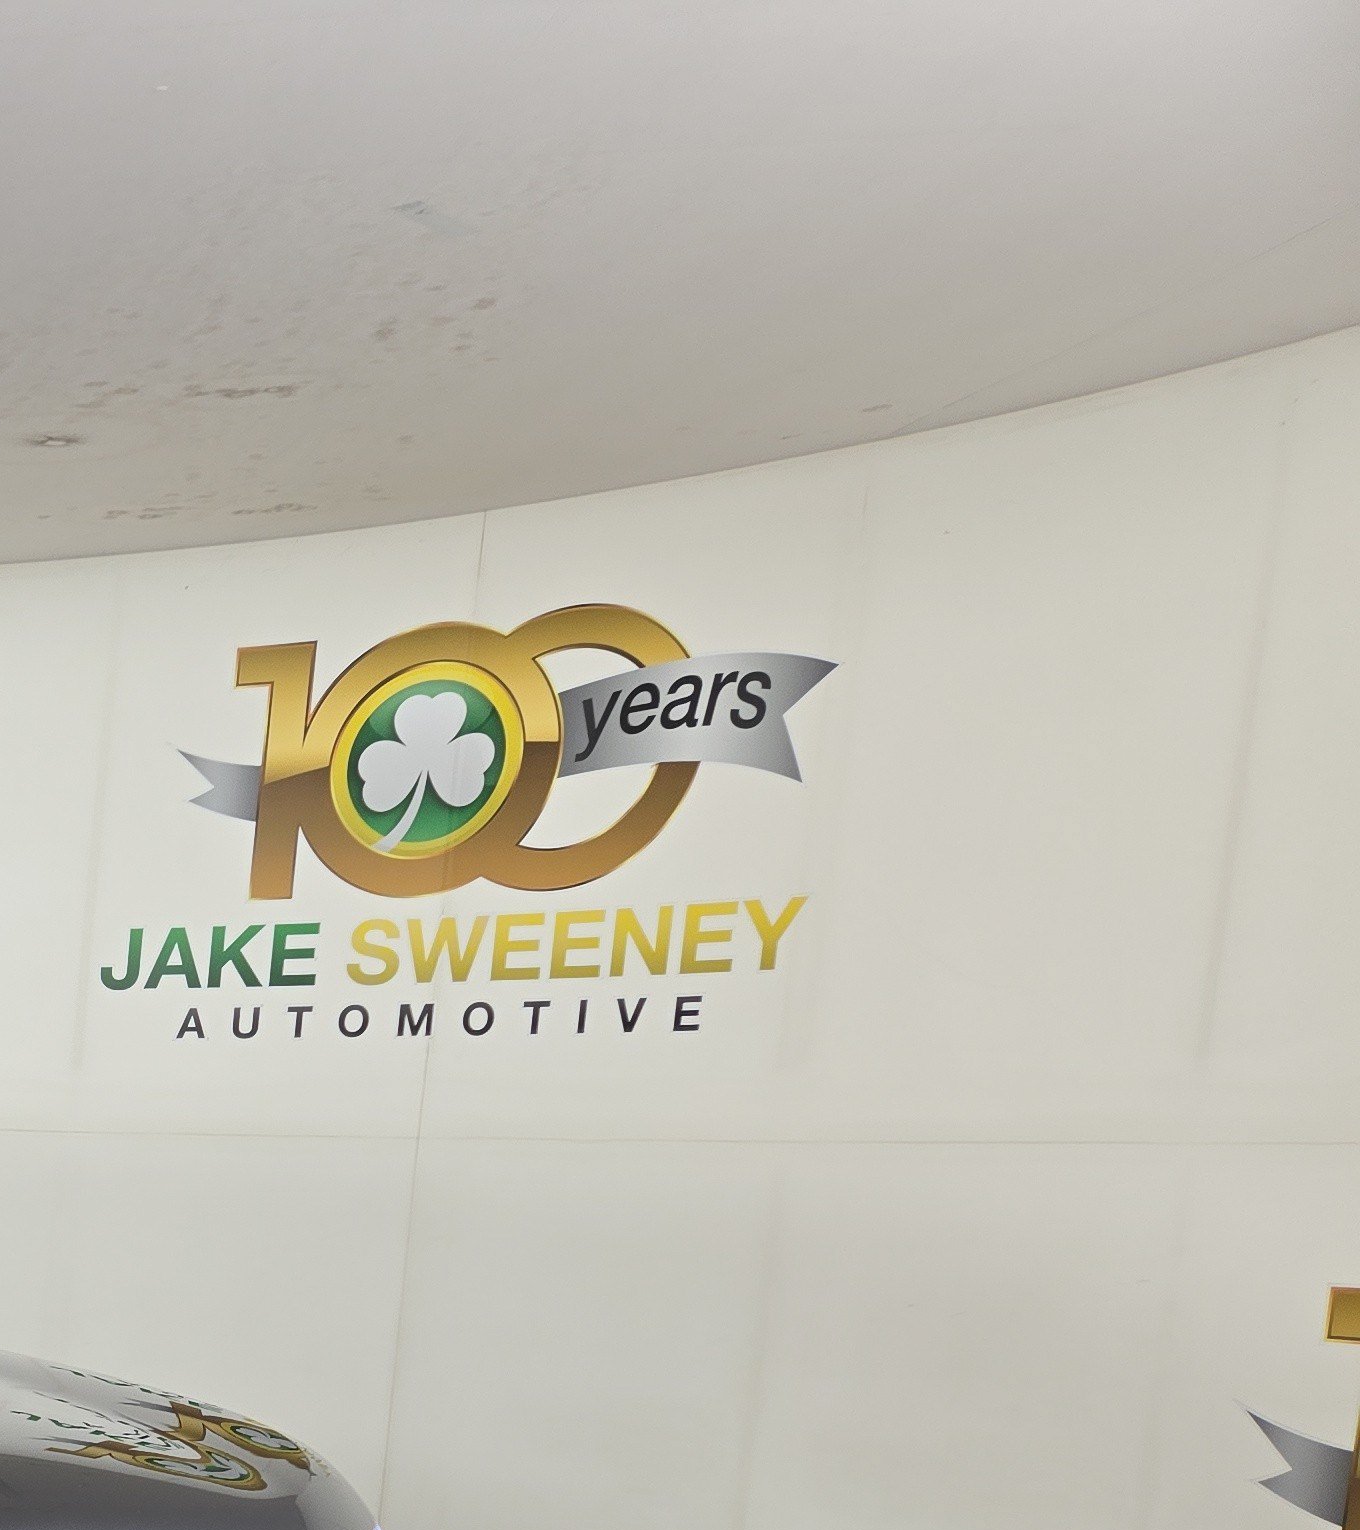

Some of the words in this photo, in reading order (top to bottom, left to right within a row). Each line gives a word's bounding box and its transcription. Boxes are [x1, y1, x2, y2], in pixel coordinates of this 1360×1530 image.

[236, 603, 701, 899] 100
[575, 667, 772, 762] years
[100, 922, 321, 991] JAKE
[345, 896, 809, 987] SWEENEY
[176, 995, 704, 1040] AUTOMOTIVE
